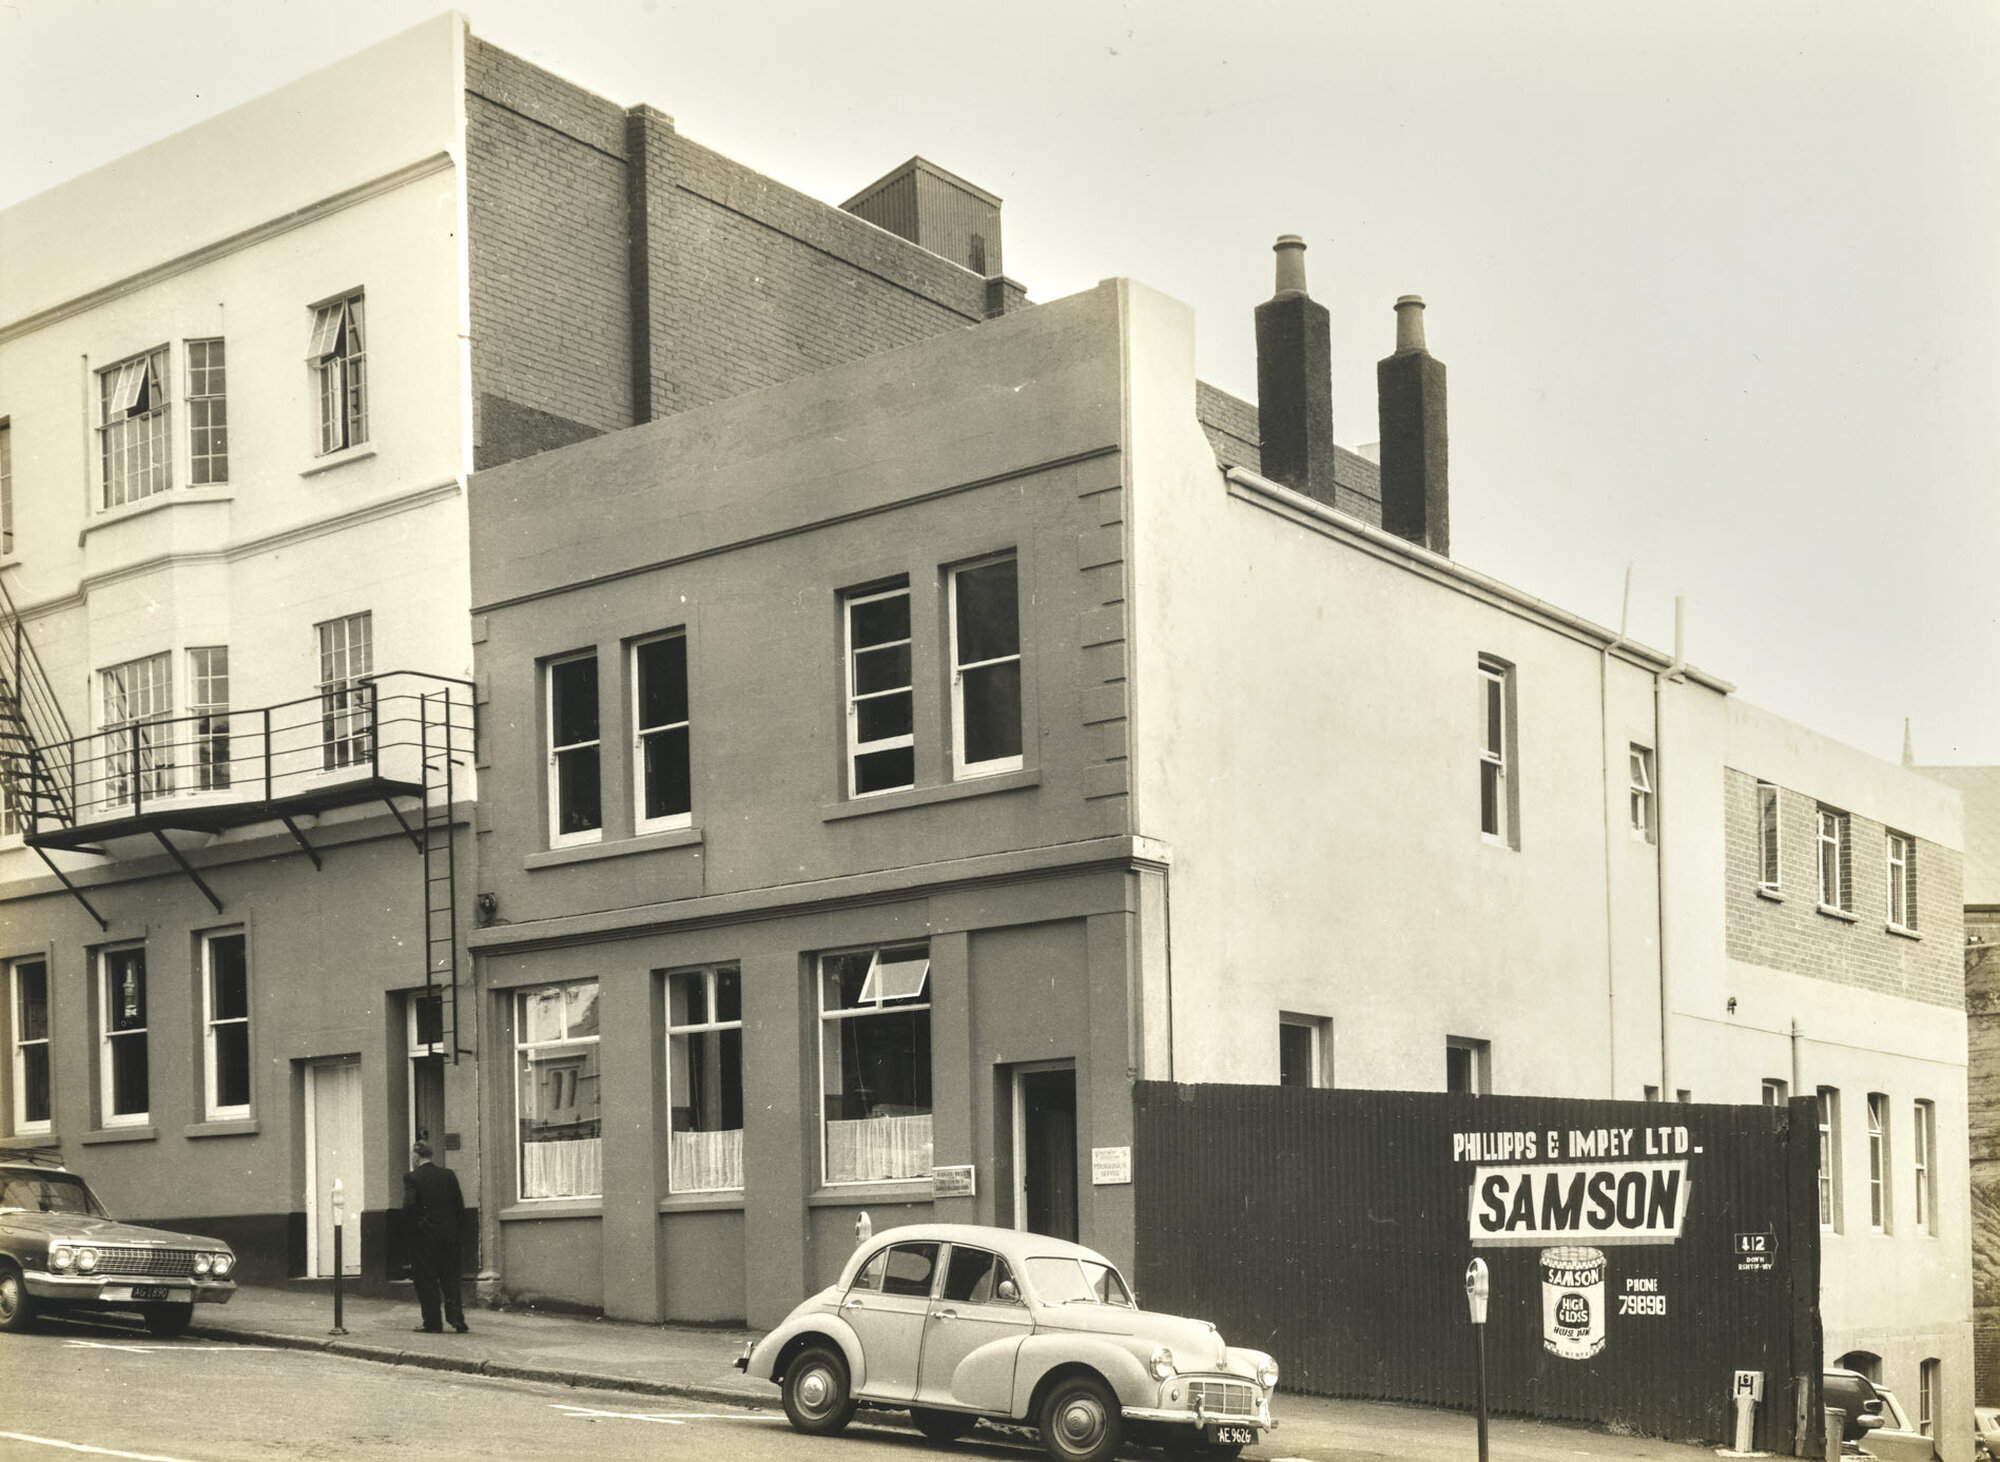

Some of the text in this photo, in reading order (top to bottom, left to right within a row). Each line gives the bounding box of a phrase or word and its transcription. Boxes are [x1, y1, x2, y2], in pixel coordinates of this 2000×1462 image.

[1453, 1131, 1537, 1161] PHILLIPPS
[1547, 1131, 1559, 1158] &
[1569, 1128, 1634, 1157] IMPEY
[1478, 1169, 1681, 1232] SAMSON
[1741, 1236, 1765, 1251] 412
[1548, 1268, 1599, 1286] SAMSON
[1626, 1278, 1658, 1292] PHONE
[1558, 1309, 1588, 1323] GLOSS
[1553, 1326, 1574, 1337] HOUSE
[1737, 1375, 1754, 1396] H
[1743, 1374, 1749, 1384] 6
[1219, 1427, 1251, 1443] AE 9626
